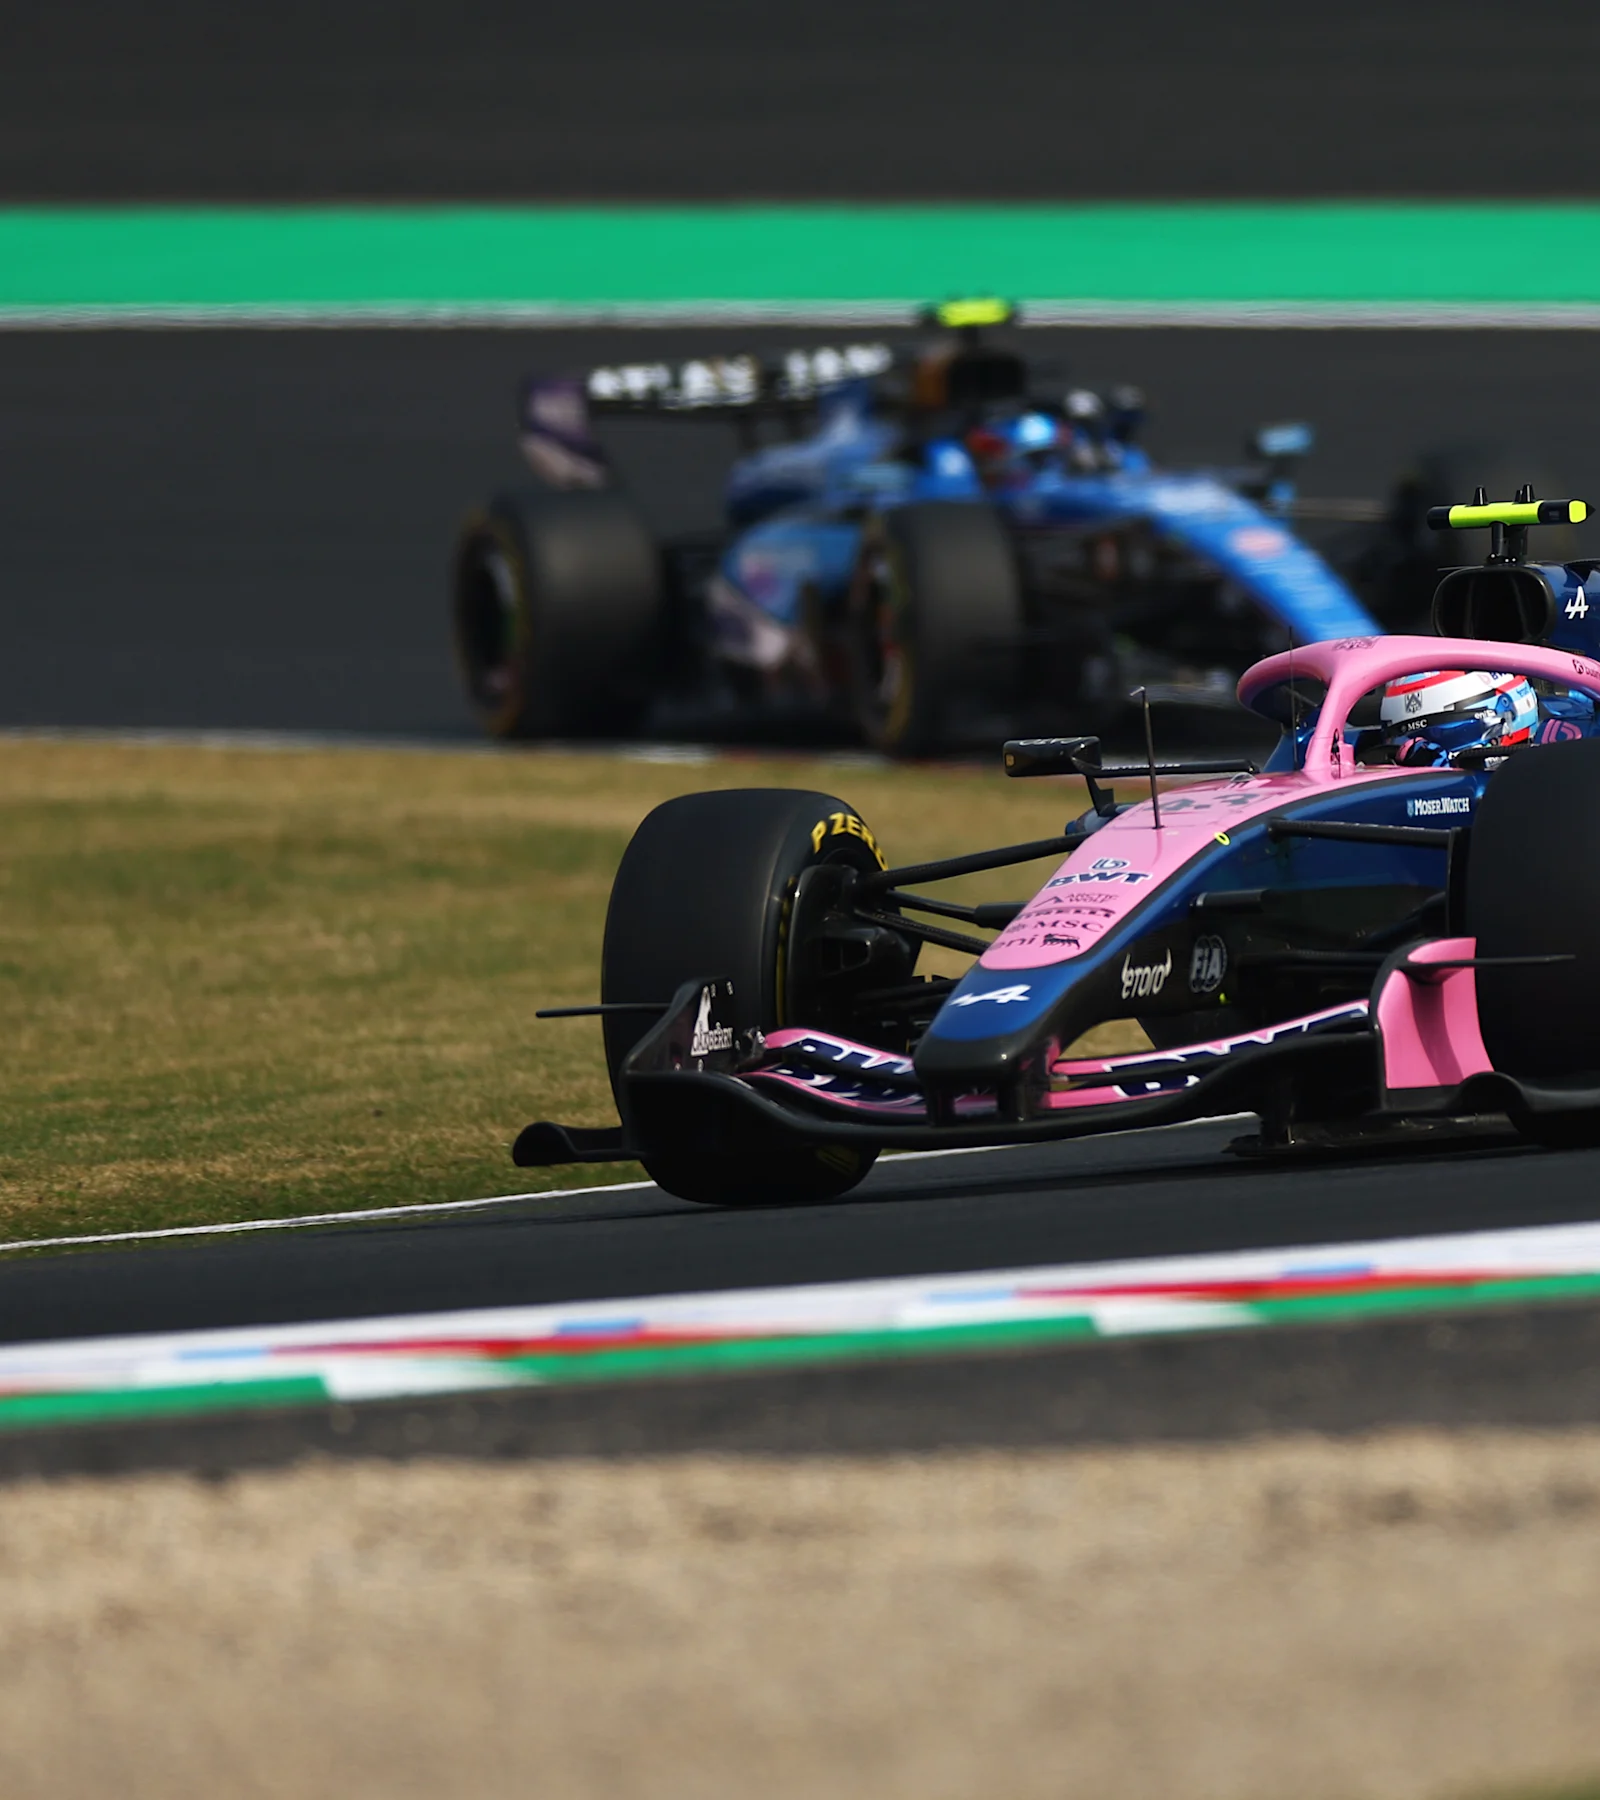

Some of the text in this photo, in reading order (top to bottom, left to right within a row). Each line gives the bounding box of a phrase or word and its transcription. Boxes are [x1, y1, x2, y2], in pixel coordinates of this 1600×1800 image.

[1407, 719, 1427, 732] MSC
[811, 820, 825, 854] P
[1044, 870, 1154, 891] BWT
[1033, 919, 1105, 933] MSC
